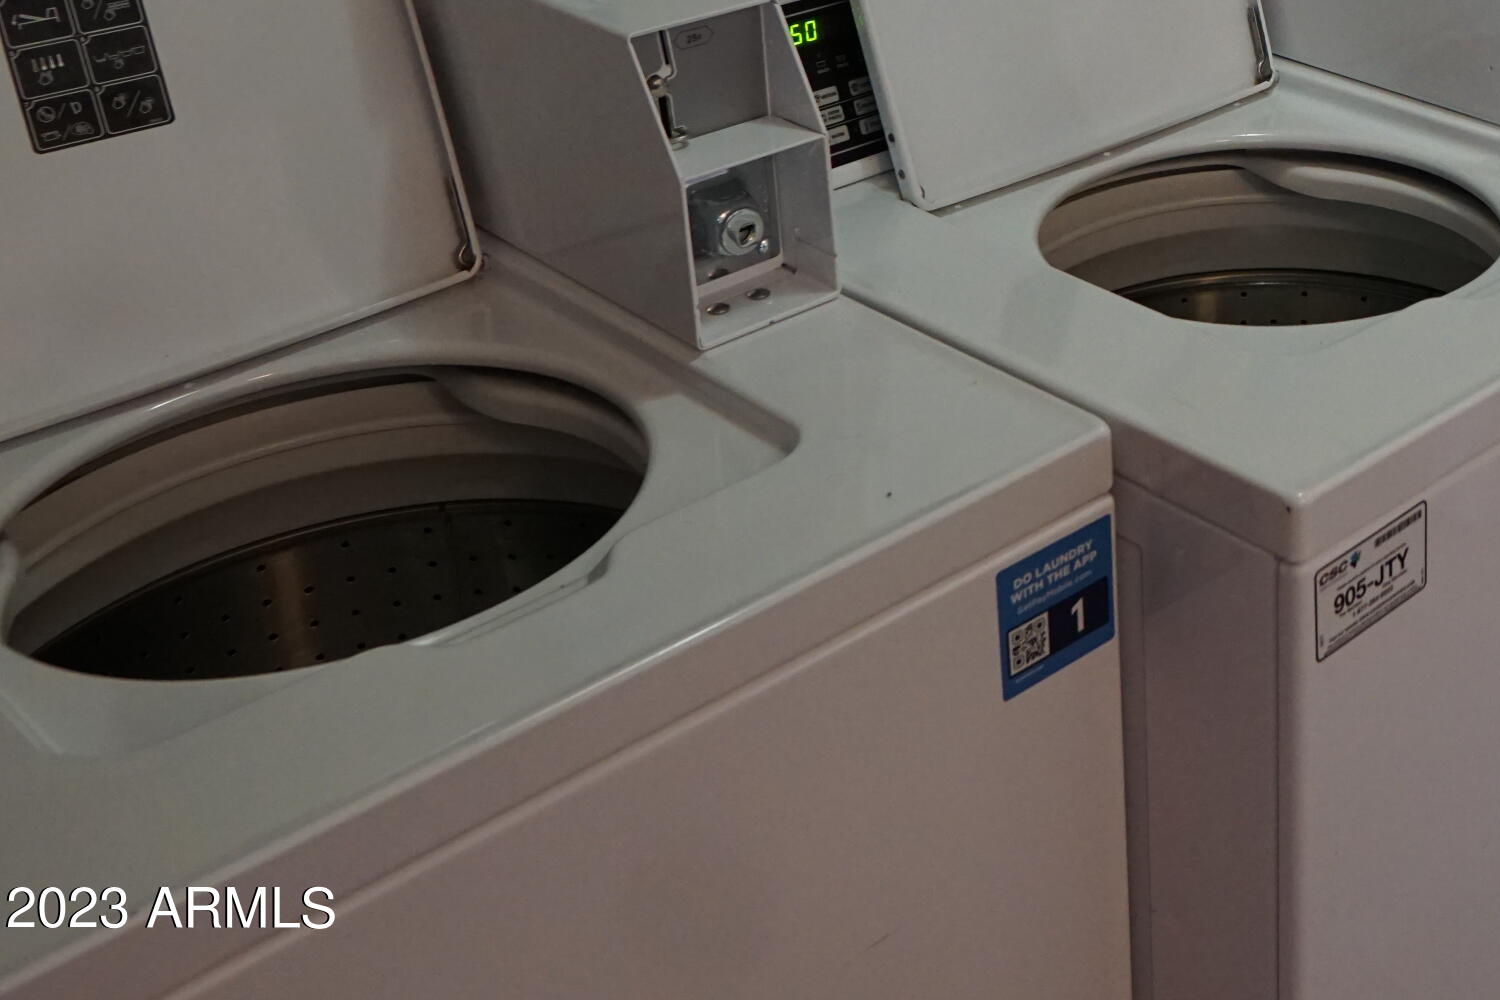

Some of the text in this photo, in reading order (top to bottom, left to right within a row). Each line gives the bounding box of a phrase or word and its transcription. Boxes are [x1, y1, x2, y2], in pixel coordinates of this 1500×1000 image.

[790, 19, 818, 45] 50
[1010, 550, 1098, 606] WITH THE APP
[1012, 539, 1093, 591] DO LAUNDRY
[1319, 560, 1348, 586] CSC
[1334, 547, 1409, 615] 905-JTY
[1070, 597, 1085, 633] 1
